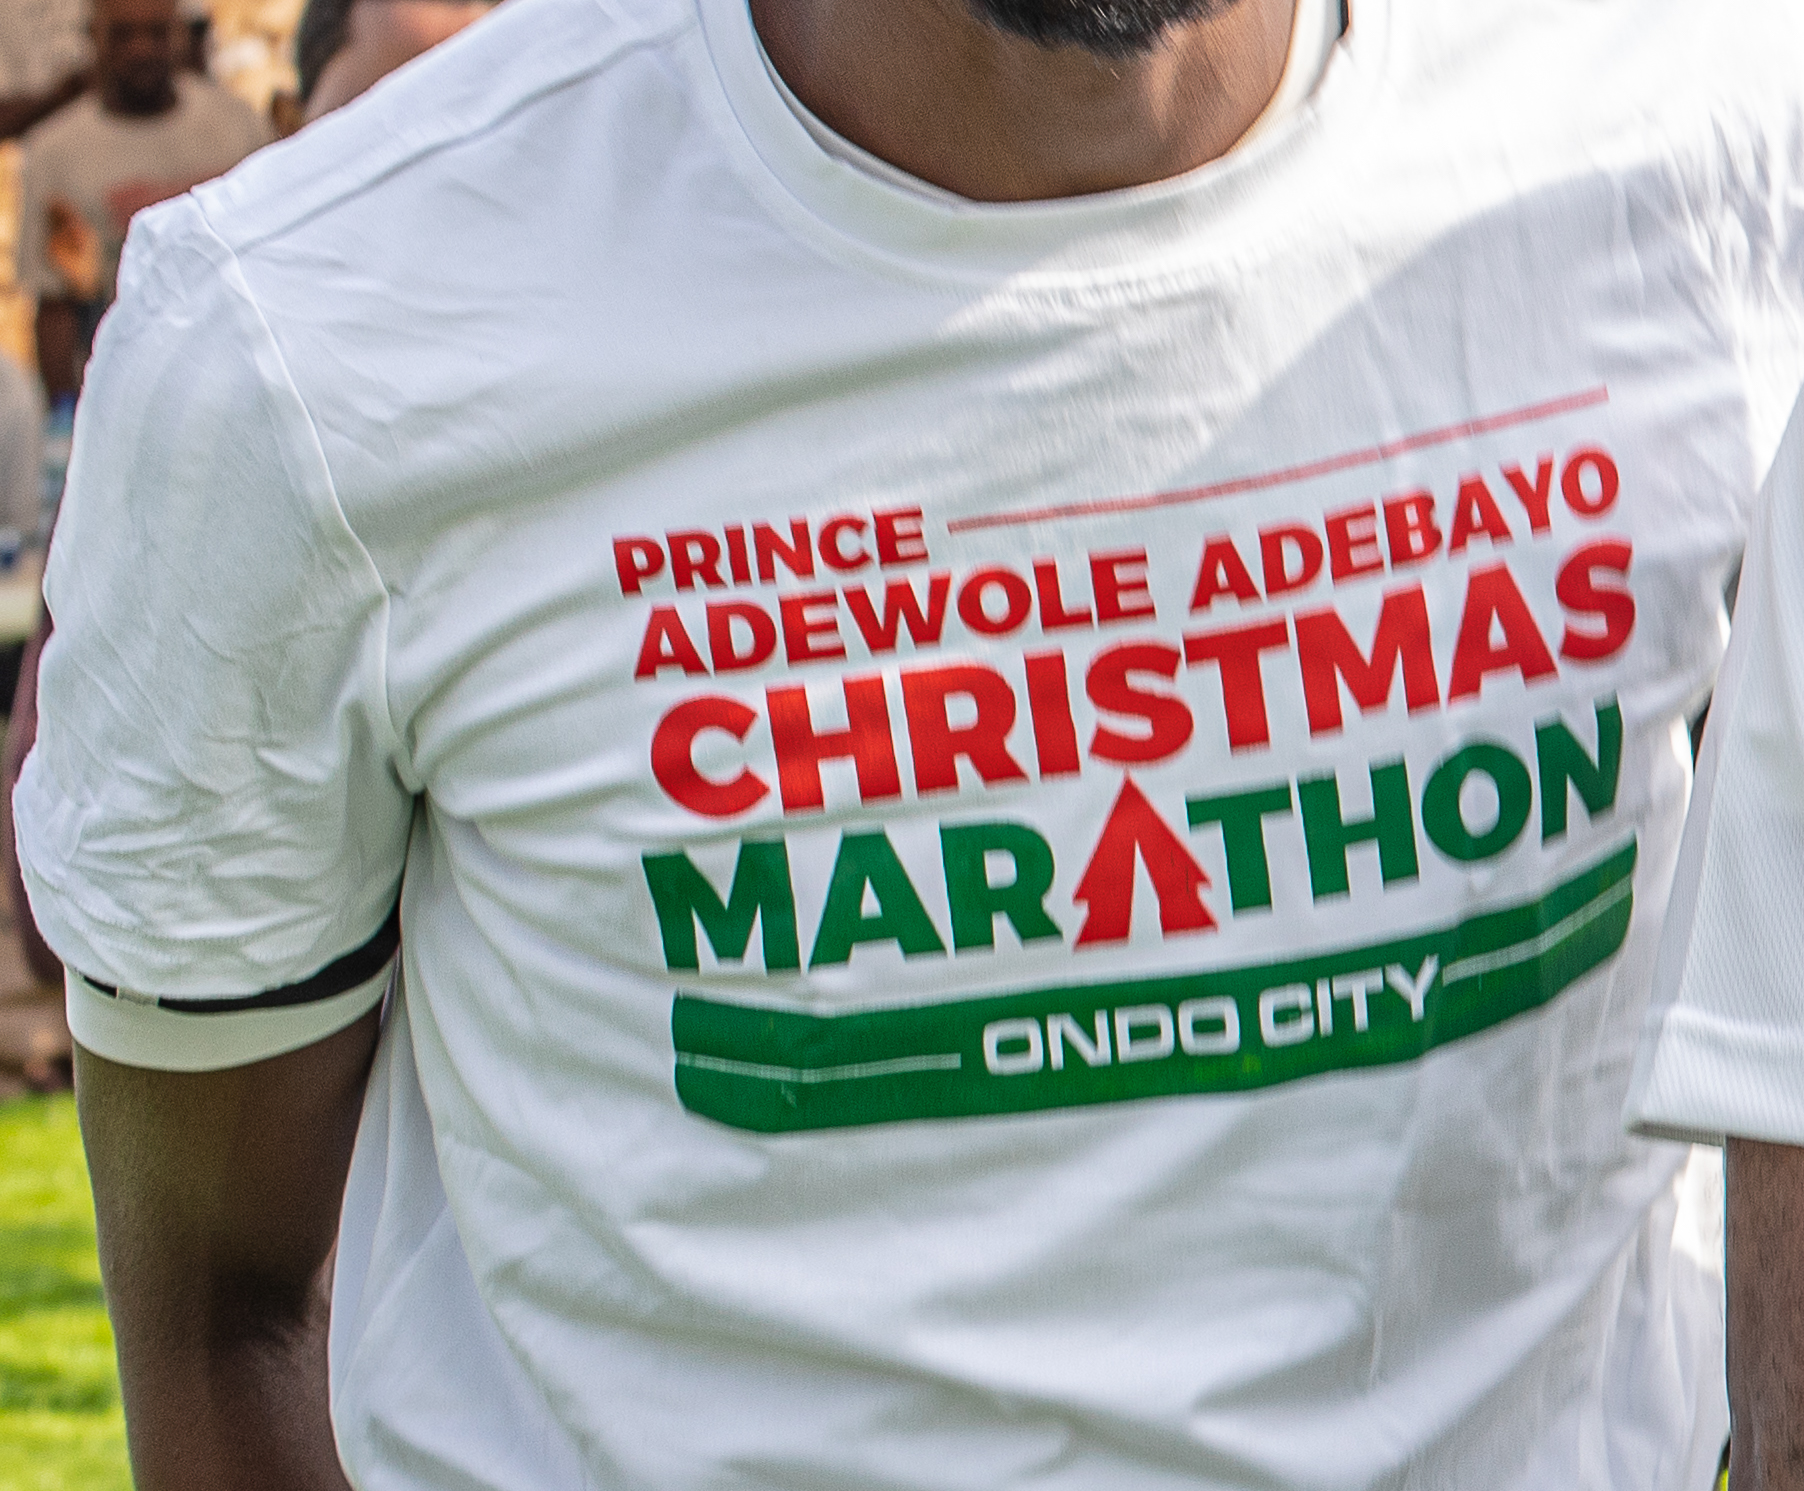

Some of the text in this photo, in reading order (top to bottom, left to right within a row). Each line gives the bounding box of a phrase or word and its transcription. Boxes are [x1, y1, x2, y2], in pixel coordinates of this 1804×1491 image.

[611, 505, 929, 597] PRINCE
[635, 442, 1620, 682] ADEWOLE ADEBAYO
[650, 535, 1637, 822] CHRISTMAS
[641, 691, 1623, 977] MARATHON
[982, 954, 1440, 1077] ONDO CITY
